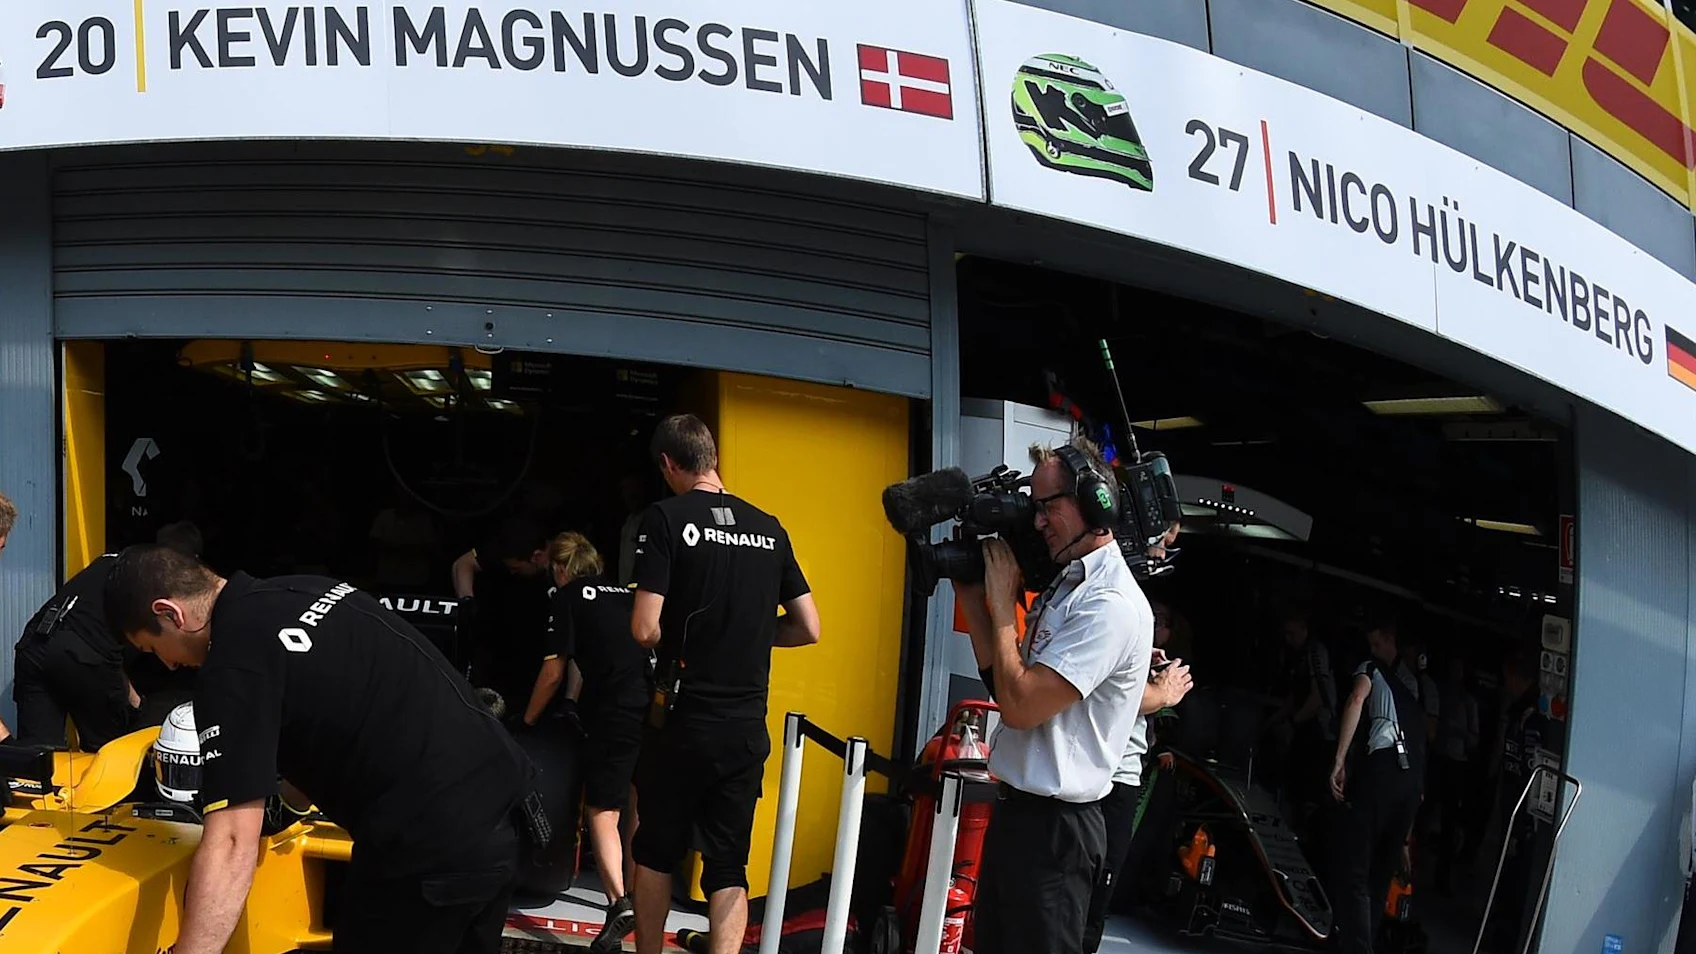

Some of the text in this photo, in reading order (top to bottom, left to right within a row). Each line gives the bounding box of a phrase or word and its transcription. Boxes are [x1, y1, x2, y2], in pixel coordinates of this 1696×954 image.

[36, 6, 832, 101] 20 KEVIN MAGNUSSEN
[1048, 62, 1080, 75] NEC
[1185, 119, 1653, 365] 27 NICO HÜLKENBERG
[704, 527, 776, 551] RENAULT
[299, 582, 358, 627] RENAU
[379, 597, 459, 615] AULT
[156, 751, 201, 766] RENAU
